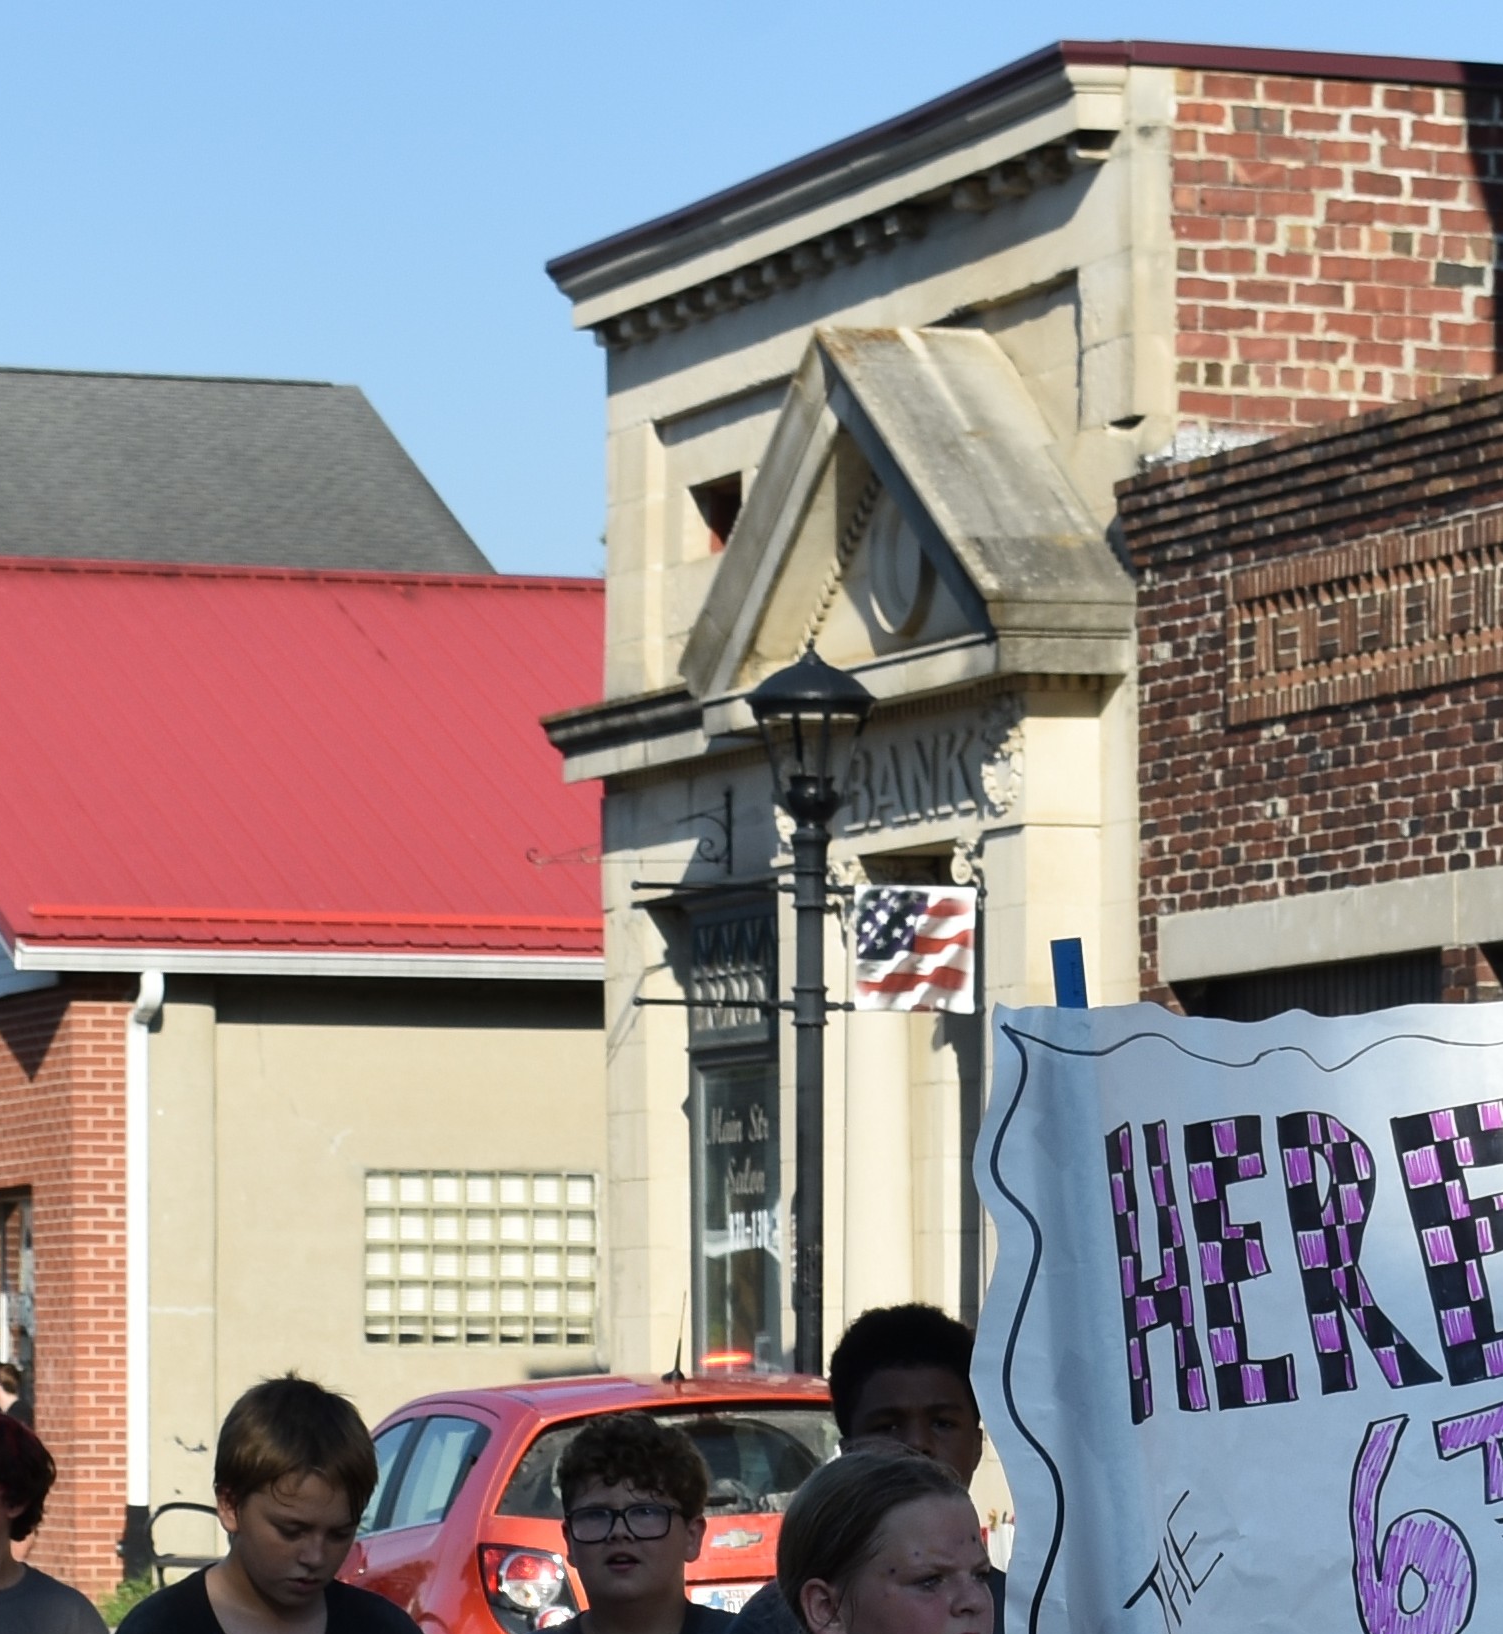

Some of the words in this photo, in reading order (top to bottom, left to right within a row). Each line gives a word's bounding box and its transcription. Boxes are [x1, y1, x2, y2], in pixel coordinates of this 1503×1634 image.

[843, 727, 979, 834] BANK
[706, 1106, 743, 1144] Main
[726, 1157, 766, 1194] Salon
